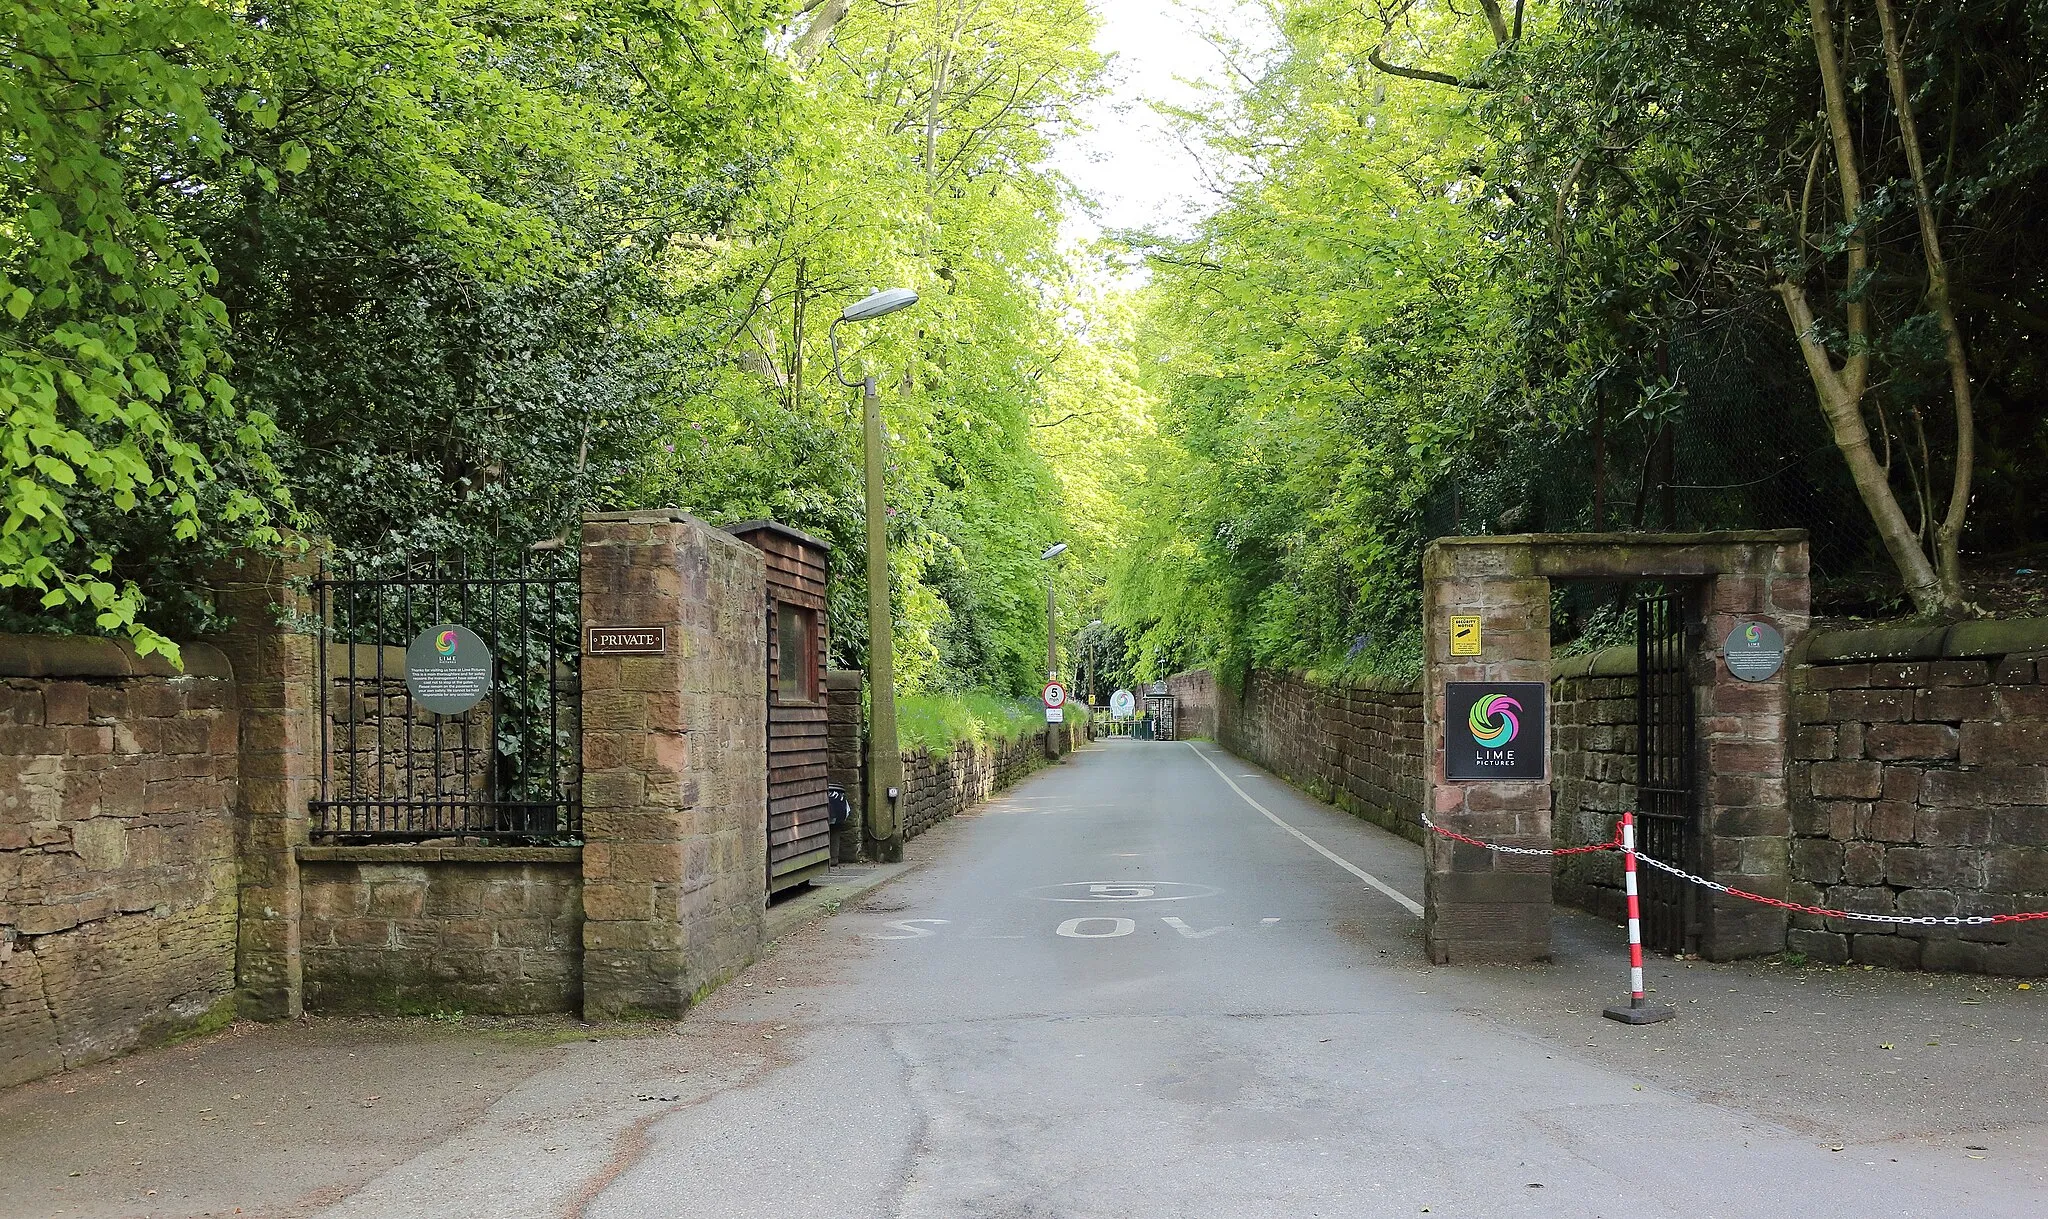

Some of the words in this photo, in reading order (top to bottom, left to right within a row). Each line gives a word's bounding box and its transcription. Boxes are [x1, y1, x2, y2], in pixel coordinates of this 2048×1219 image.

[600, 634, 654, 646] PRIVATE
[1051, 688, 1058, 697] 5
[1476, 751, 1514, 759] LIME
[1089, 885, 1154, 898] 5
